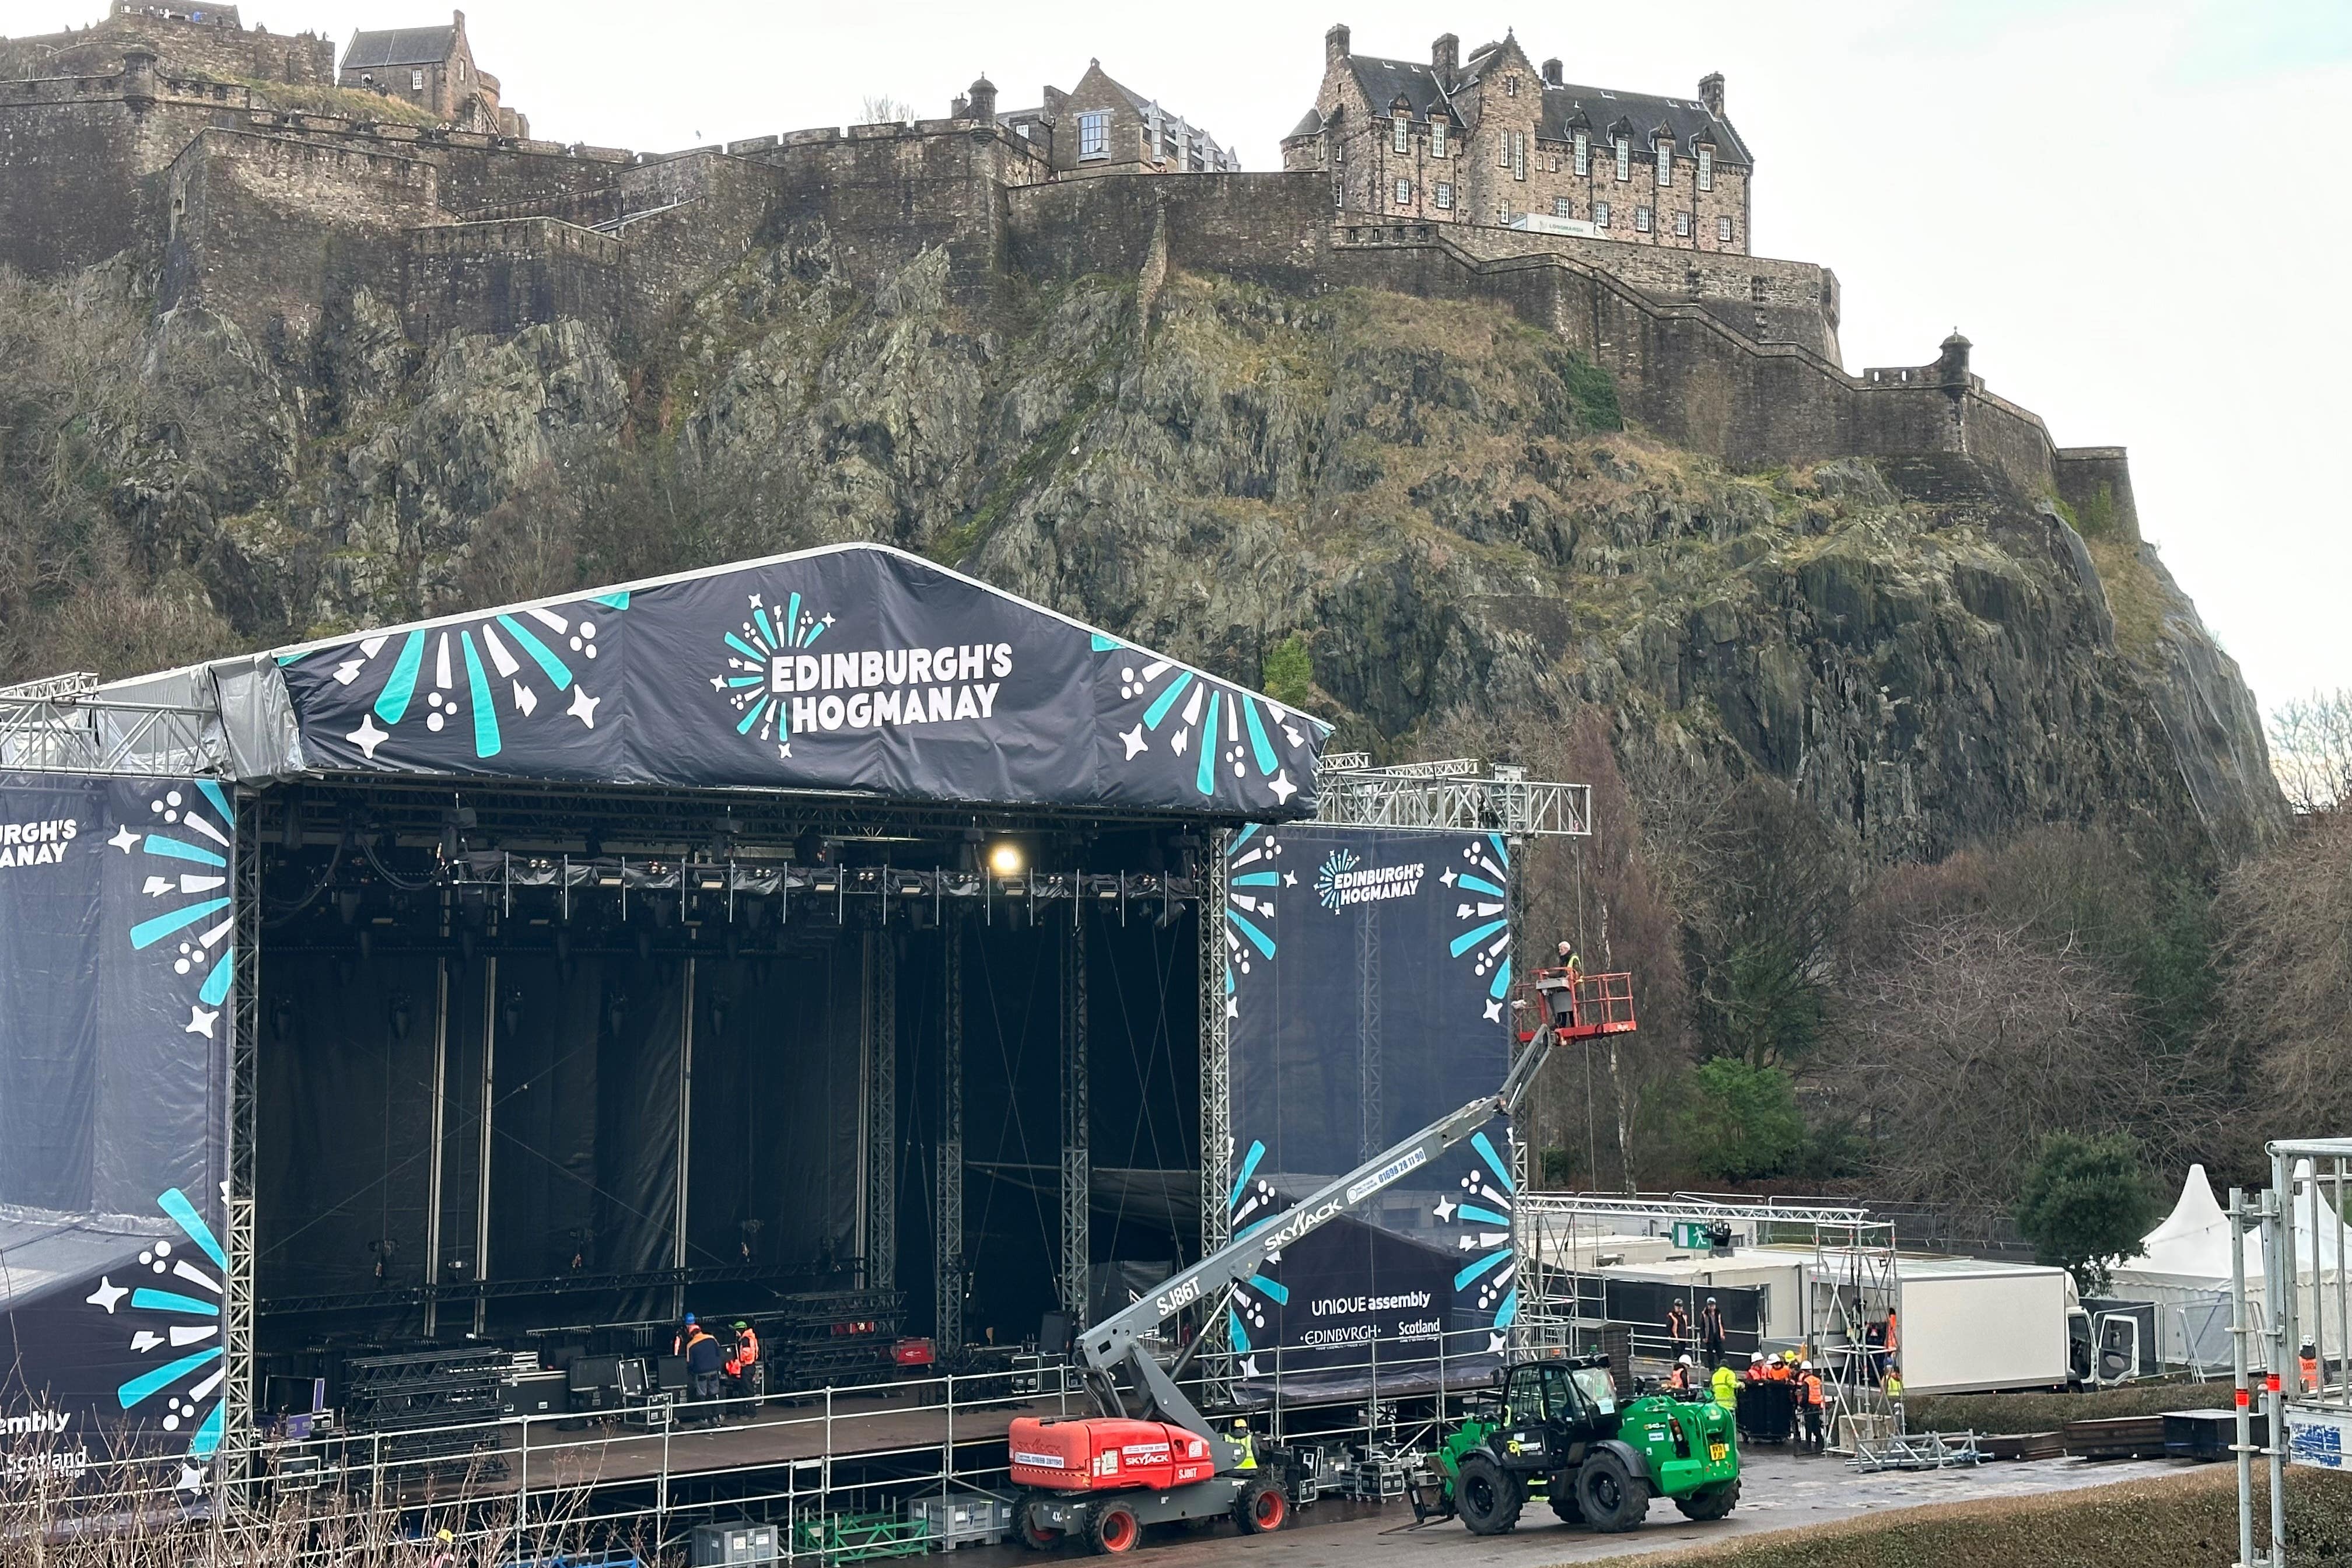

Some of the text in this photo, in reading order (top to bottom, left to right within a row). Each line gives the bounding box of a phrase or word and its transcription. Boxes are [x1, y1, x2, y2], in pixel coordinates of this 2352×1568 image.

[771, 642, 1013, 693] EDINBURGH'S
[792, 682, 1000, 734] HOGMANAY
[0, 819, 77, 845] RGH'S
[1334, 863, 1424, 890] EDINBURGH'S
[1340, 880, 1419, 905] HOGMANAY
[1378, 1150, 1424, 1184] 01698 28 11 90
[1264, 1198, 1343, 1251] SKYJACK
[1156, 1276, 1200, 1316] SJ86T
[1311, 1290, 1431, 1317] UNIQUE assembly
[1398, 1317, 1440, 1335] Scotland
[1125, 1452, 1169, 1465] SKYJACK
